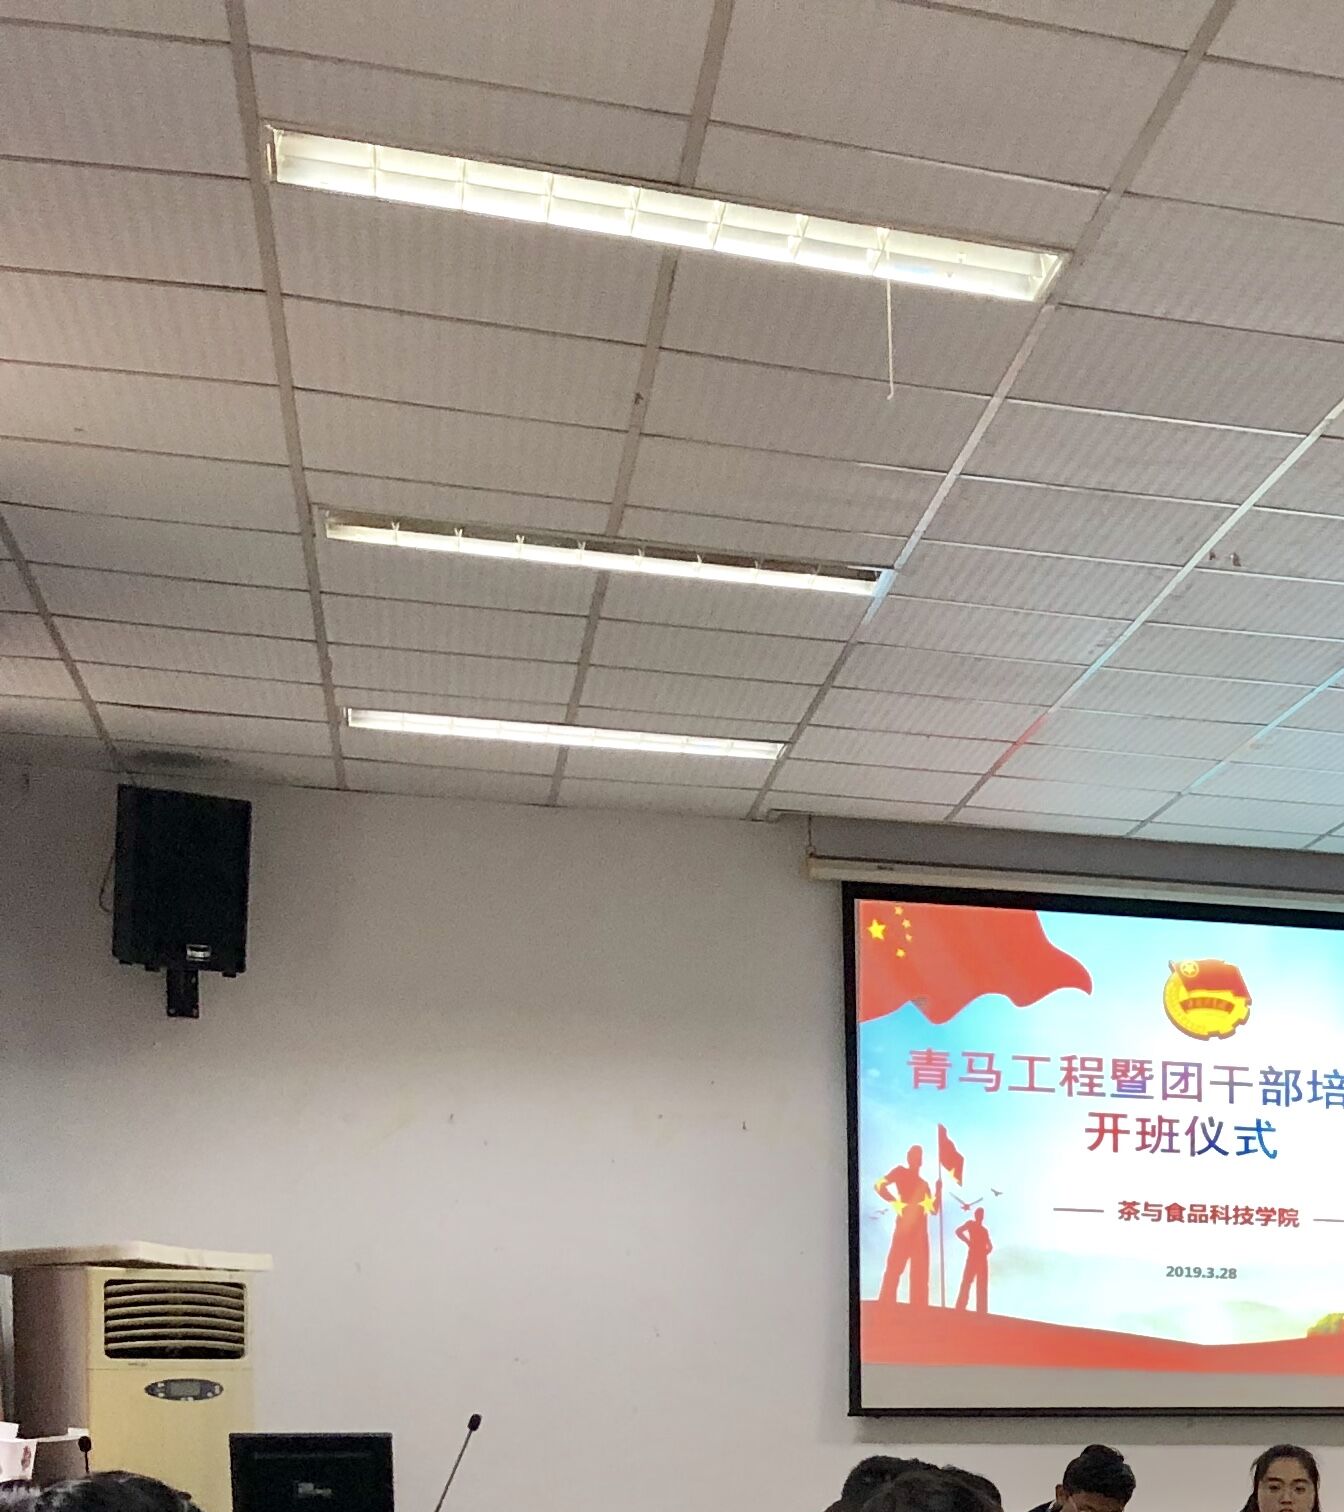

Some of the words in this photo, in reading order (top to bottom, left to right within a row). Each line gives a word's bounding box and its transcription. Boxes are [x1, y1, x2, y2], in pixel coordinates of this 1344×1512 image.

[1085, 1112, 1277, 1160] 开班仪式
[1118, 1200, 1301, 1228] 茶与食品科技学院
[1166, 1266, 1238, 1280] 2019.3.28
